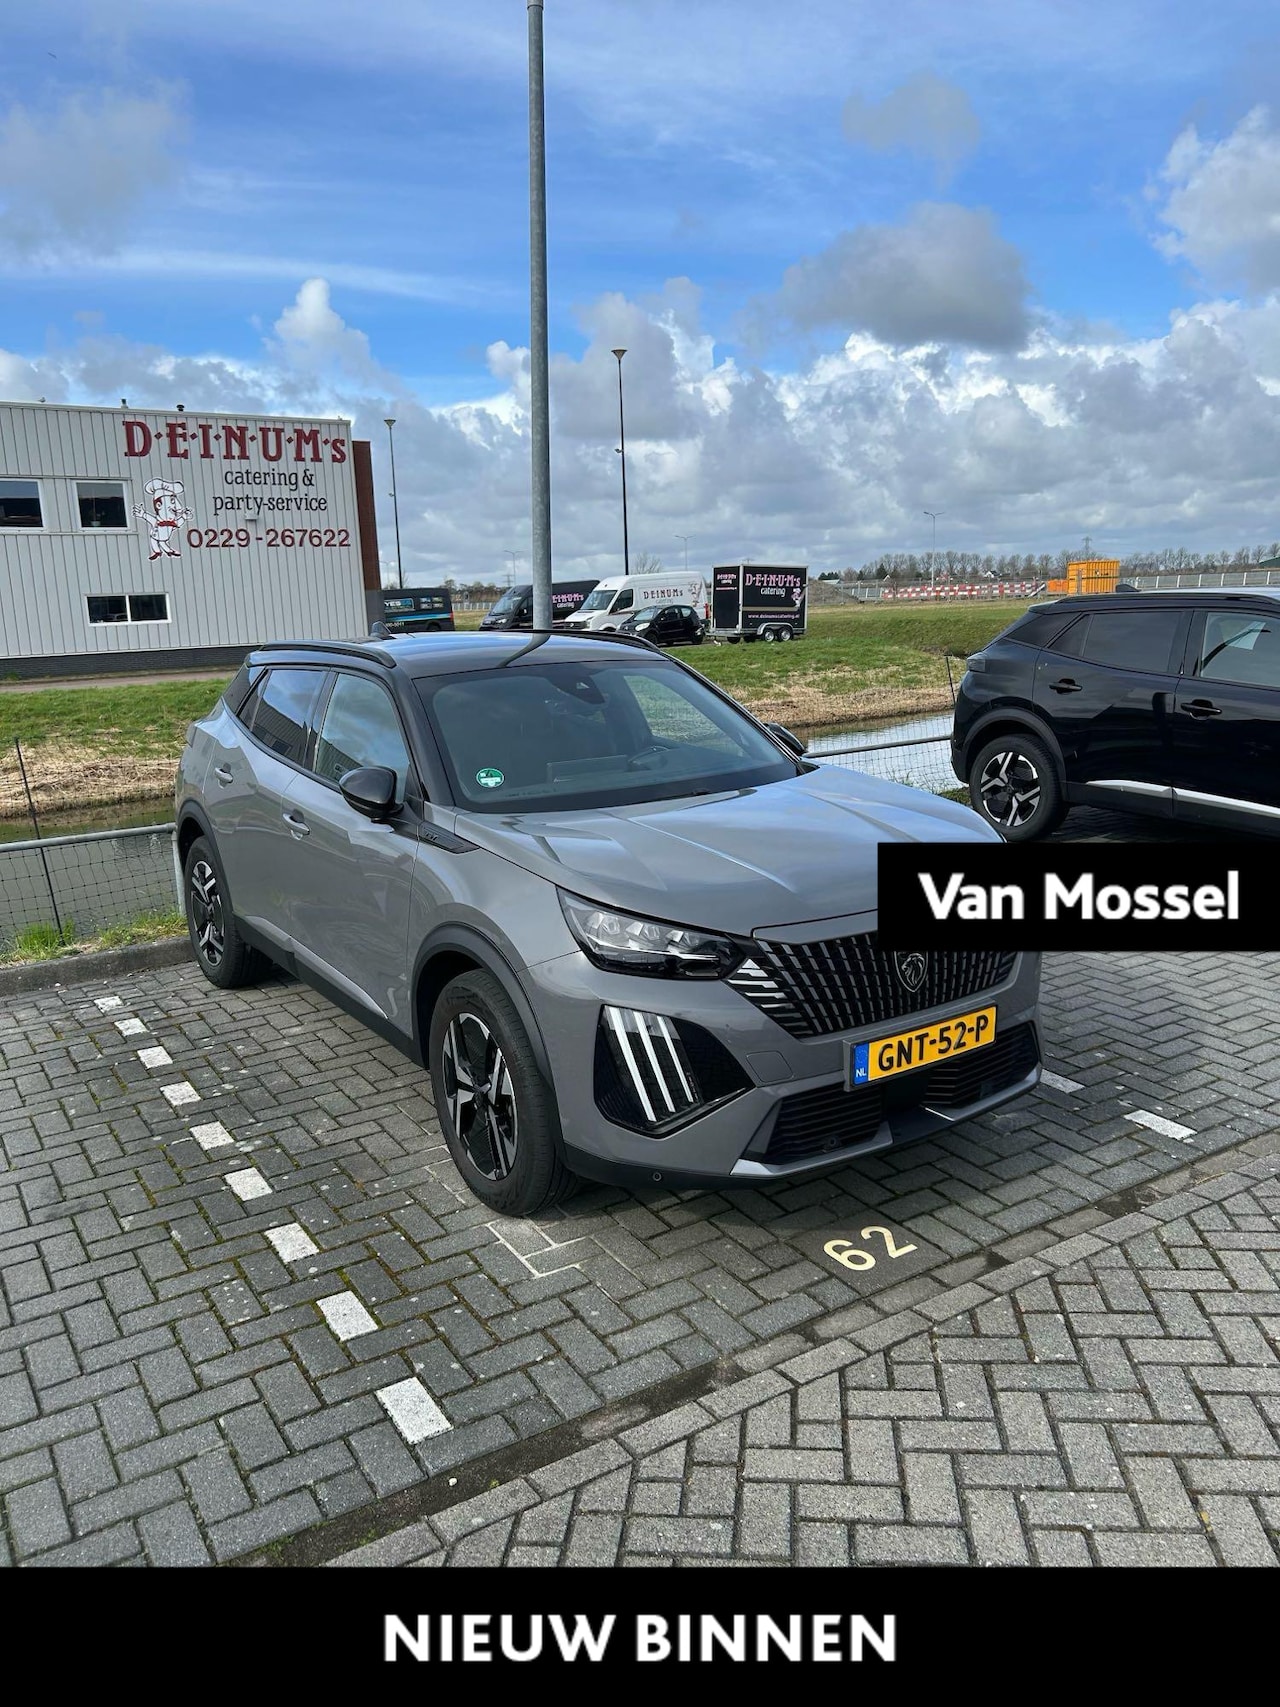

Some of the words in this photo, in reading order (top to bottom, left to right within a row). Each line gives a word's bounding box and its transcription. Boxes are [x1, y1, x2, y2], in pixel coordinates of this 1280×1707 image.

[224, 468, 297, 491] catering
[302, 468, 315, 487] &
[213, 494, 328, 516] party-service
[760, 587, 786, 598] catering
[878, 1014, 989, 1072] GNT-52-P
[855, 1067, 867, 1078] NL
[823, 1225, 918, 1271] 62
